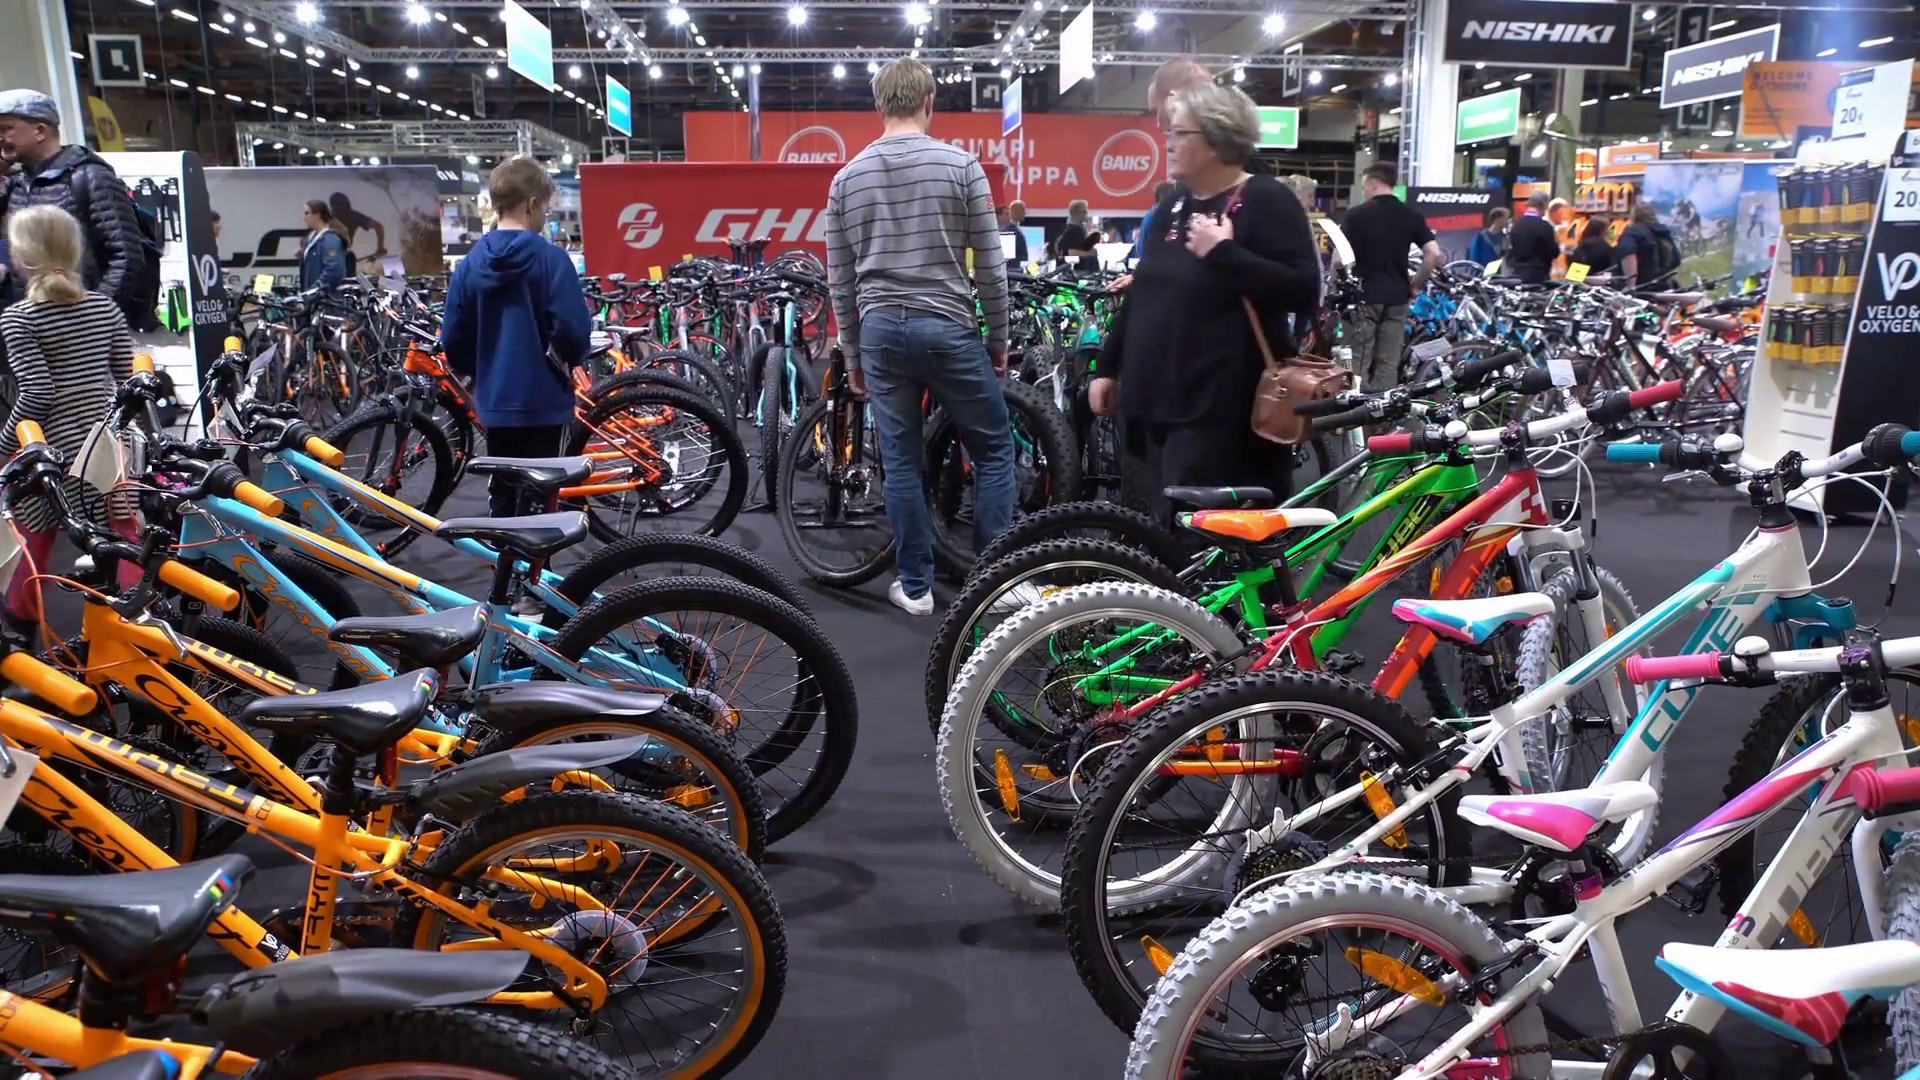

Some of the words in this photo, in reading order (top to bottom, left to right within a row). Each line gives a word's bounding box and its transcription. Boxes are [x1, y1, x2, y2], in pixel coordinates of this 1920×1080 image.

[1461, 20, 1616, 44] NISHIKI
[1671, 51, 1765, 86] NISHIKI
[1101, 155, 1152, 173] BAIKS
[1416, 192, 1491, 204] NISHIKI
[195, 300, 224, 313] VELO&
[1867, 304, 1920, 320] VELO&
[195, 311, 227, 326] OXYGEN
[1858, 318, 1920, 334] OXYGEN
[1640, 606, 1744, 752] CUE
